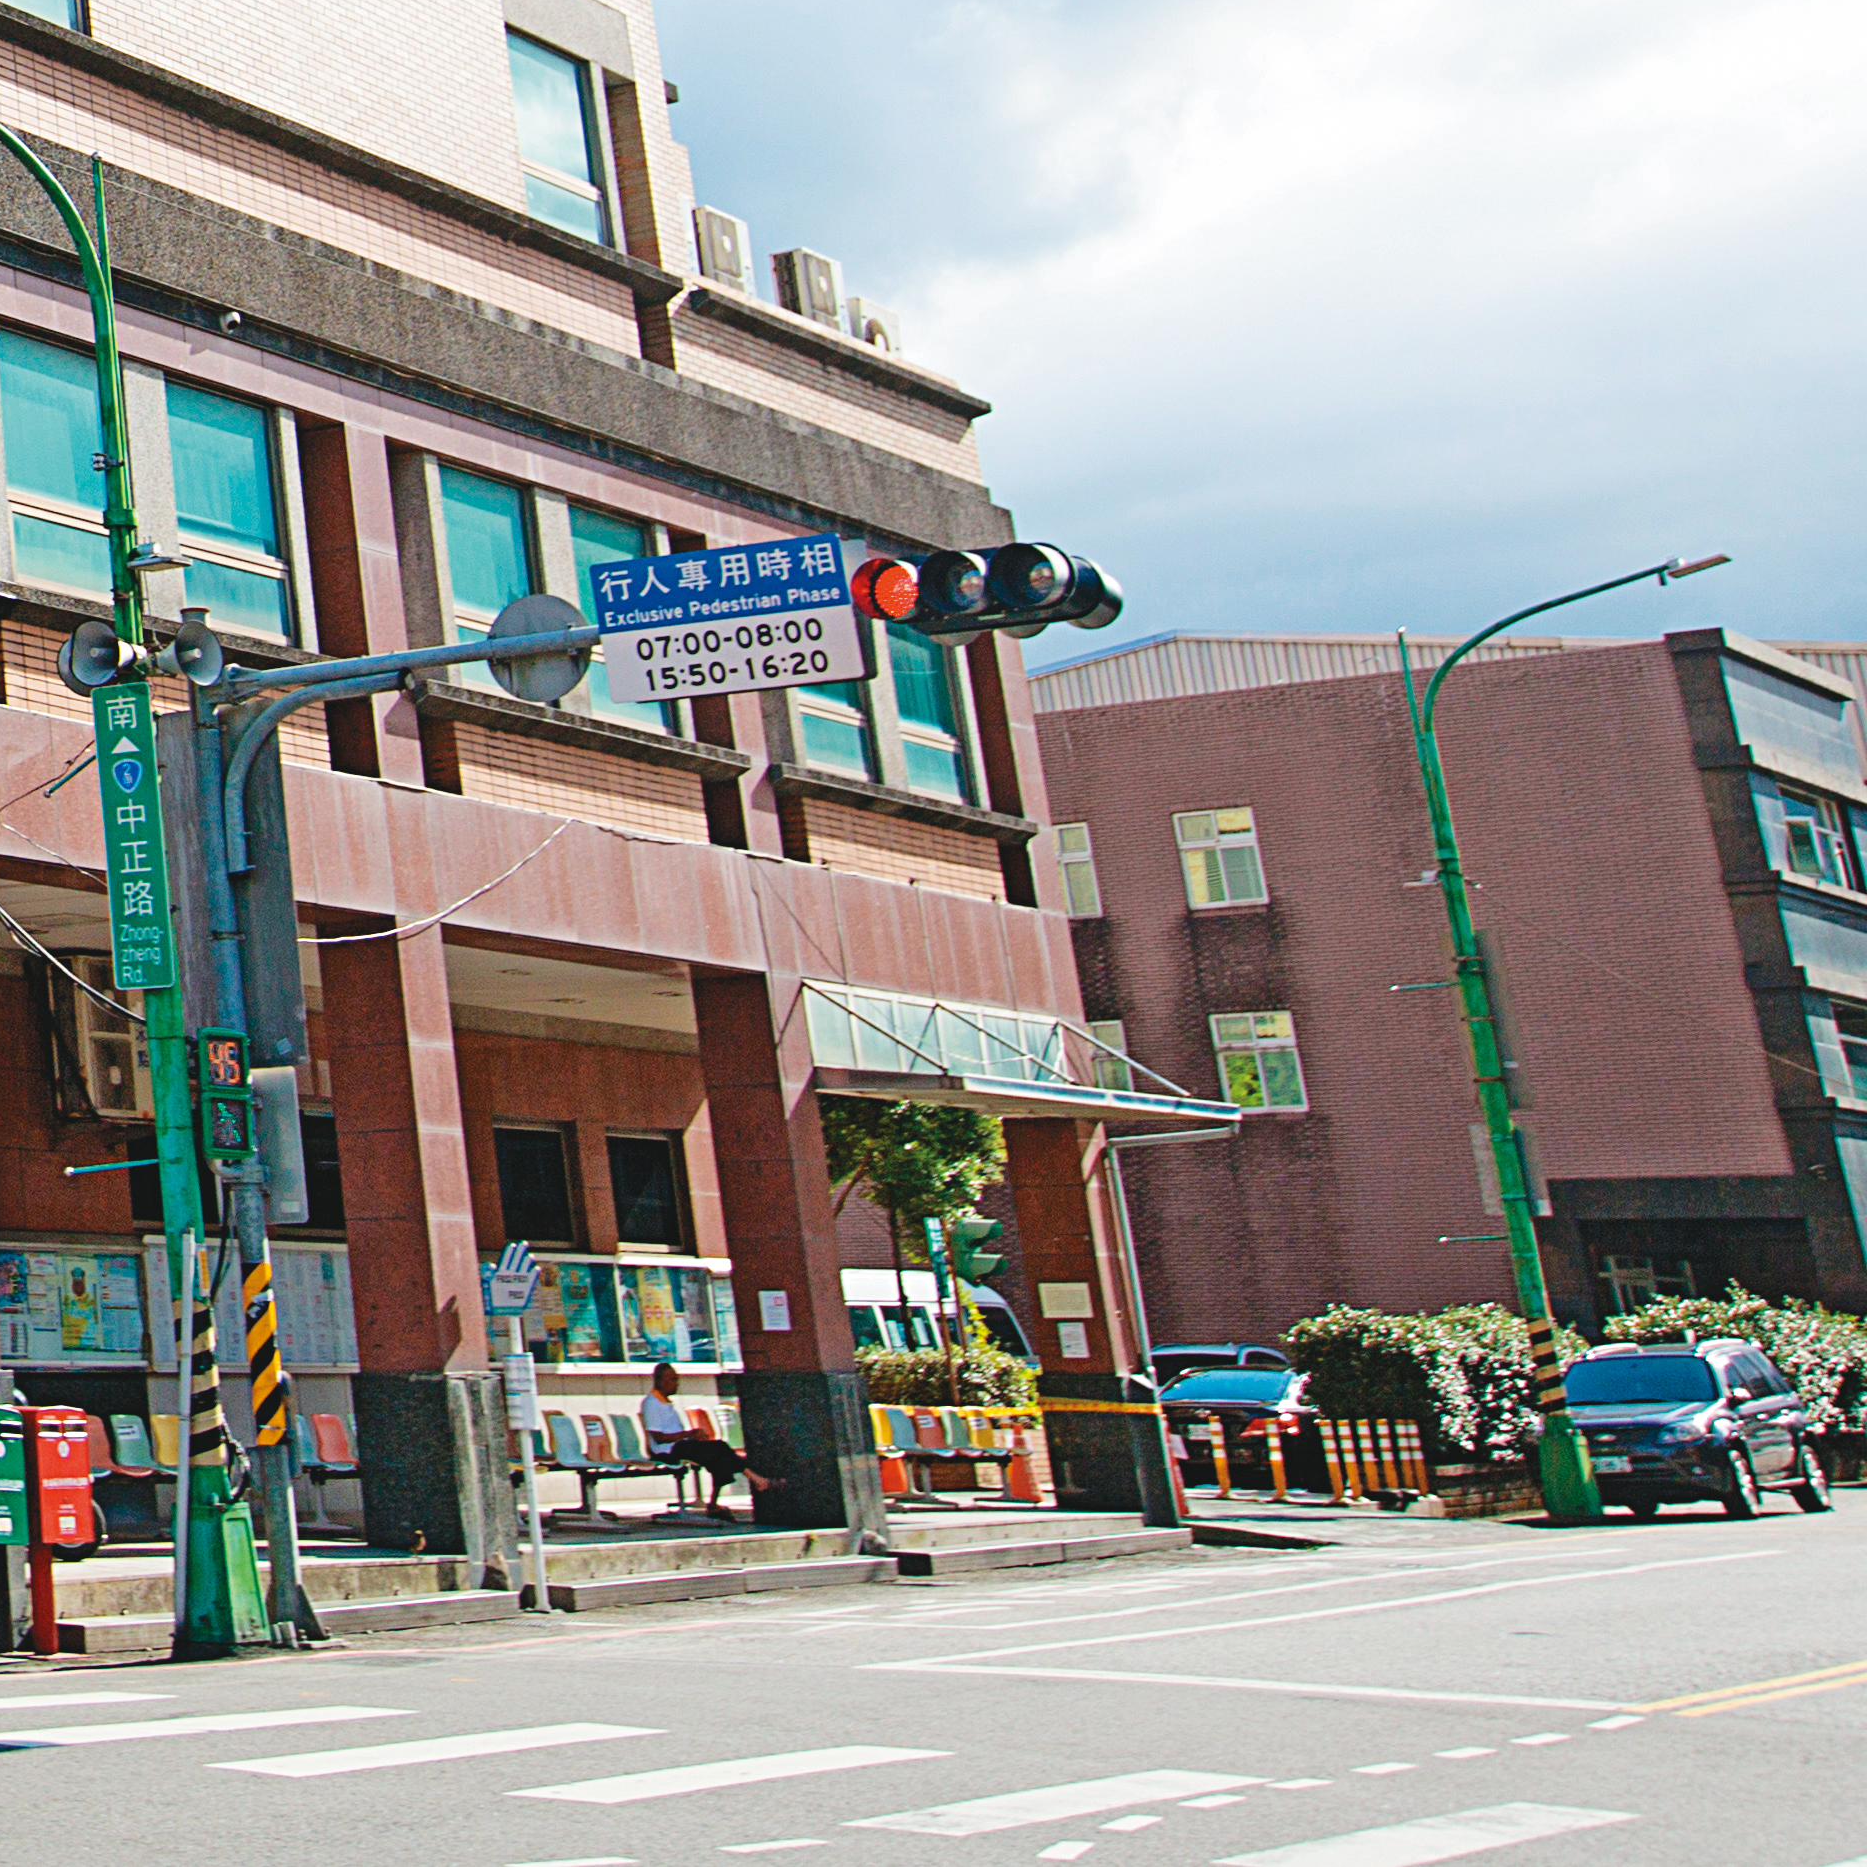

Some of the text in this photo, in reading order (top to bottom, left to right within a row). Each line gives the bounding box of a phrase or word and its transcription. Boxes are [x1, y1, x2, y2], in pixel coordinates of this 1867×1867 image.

[598, 542, 838, 603] 行人專用時相
[604, 586, 841, 628] Exclusive Pedestrian Phase
[636, 617, 824, 662] 07:00-08:00
[645, 650, 829, 692] 15:50-16:20
[105, 695, 137, 732] 南
[117, 798, 154, 918] 中正路
[120, 924, 165, 945] Zhong-
[120, 946, 162, 966] zheng
[122, 965, 148, 984] Rd.
